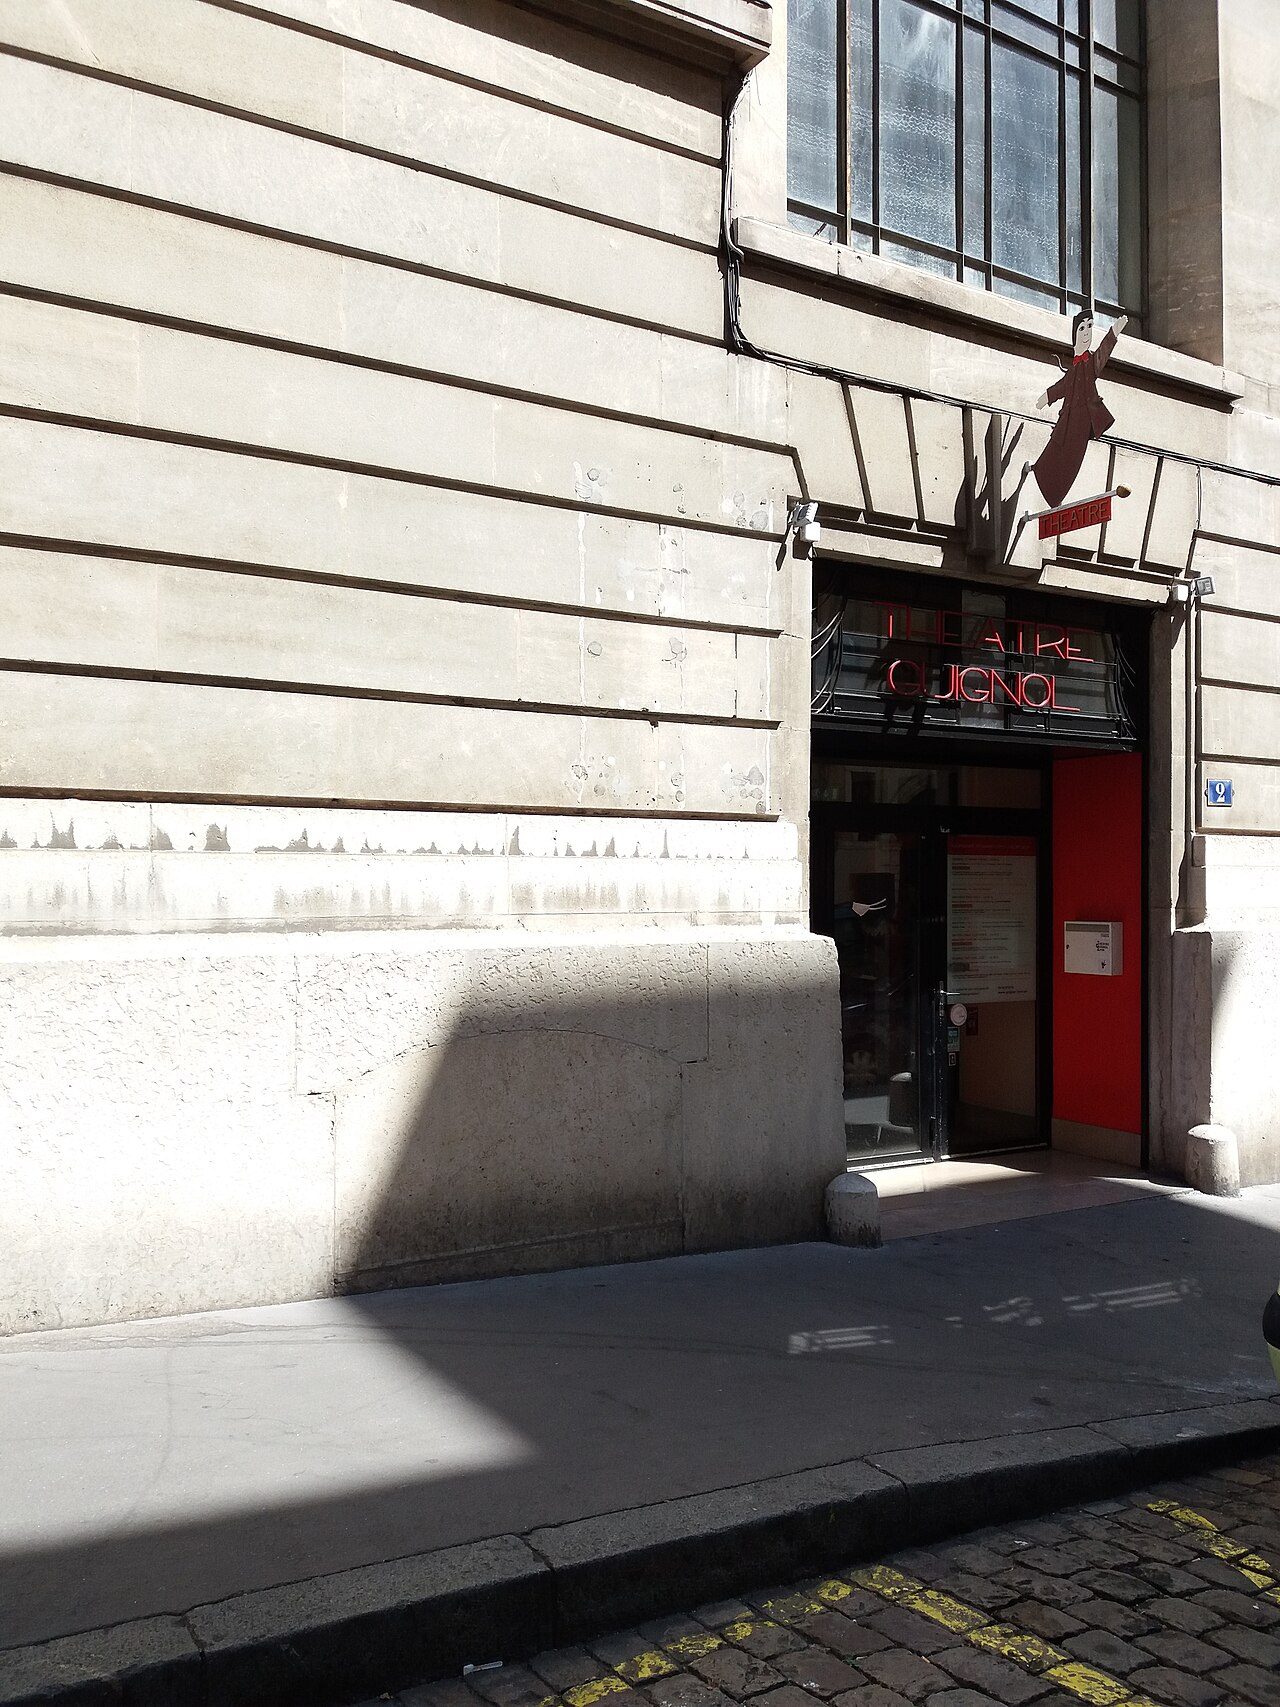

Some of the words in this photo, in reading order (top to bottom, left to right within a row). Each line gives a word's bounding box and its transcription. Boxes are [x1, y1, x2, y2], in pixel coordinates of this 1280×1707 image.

[1041, 500, 1110, 533] THEATRE
[872, 601, 1095, 661] THEATRE
[887, 659, 1081, 712] GUIGNOL
[1215, 782, 1226, 803] 2
